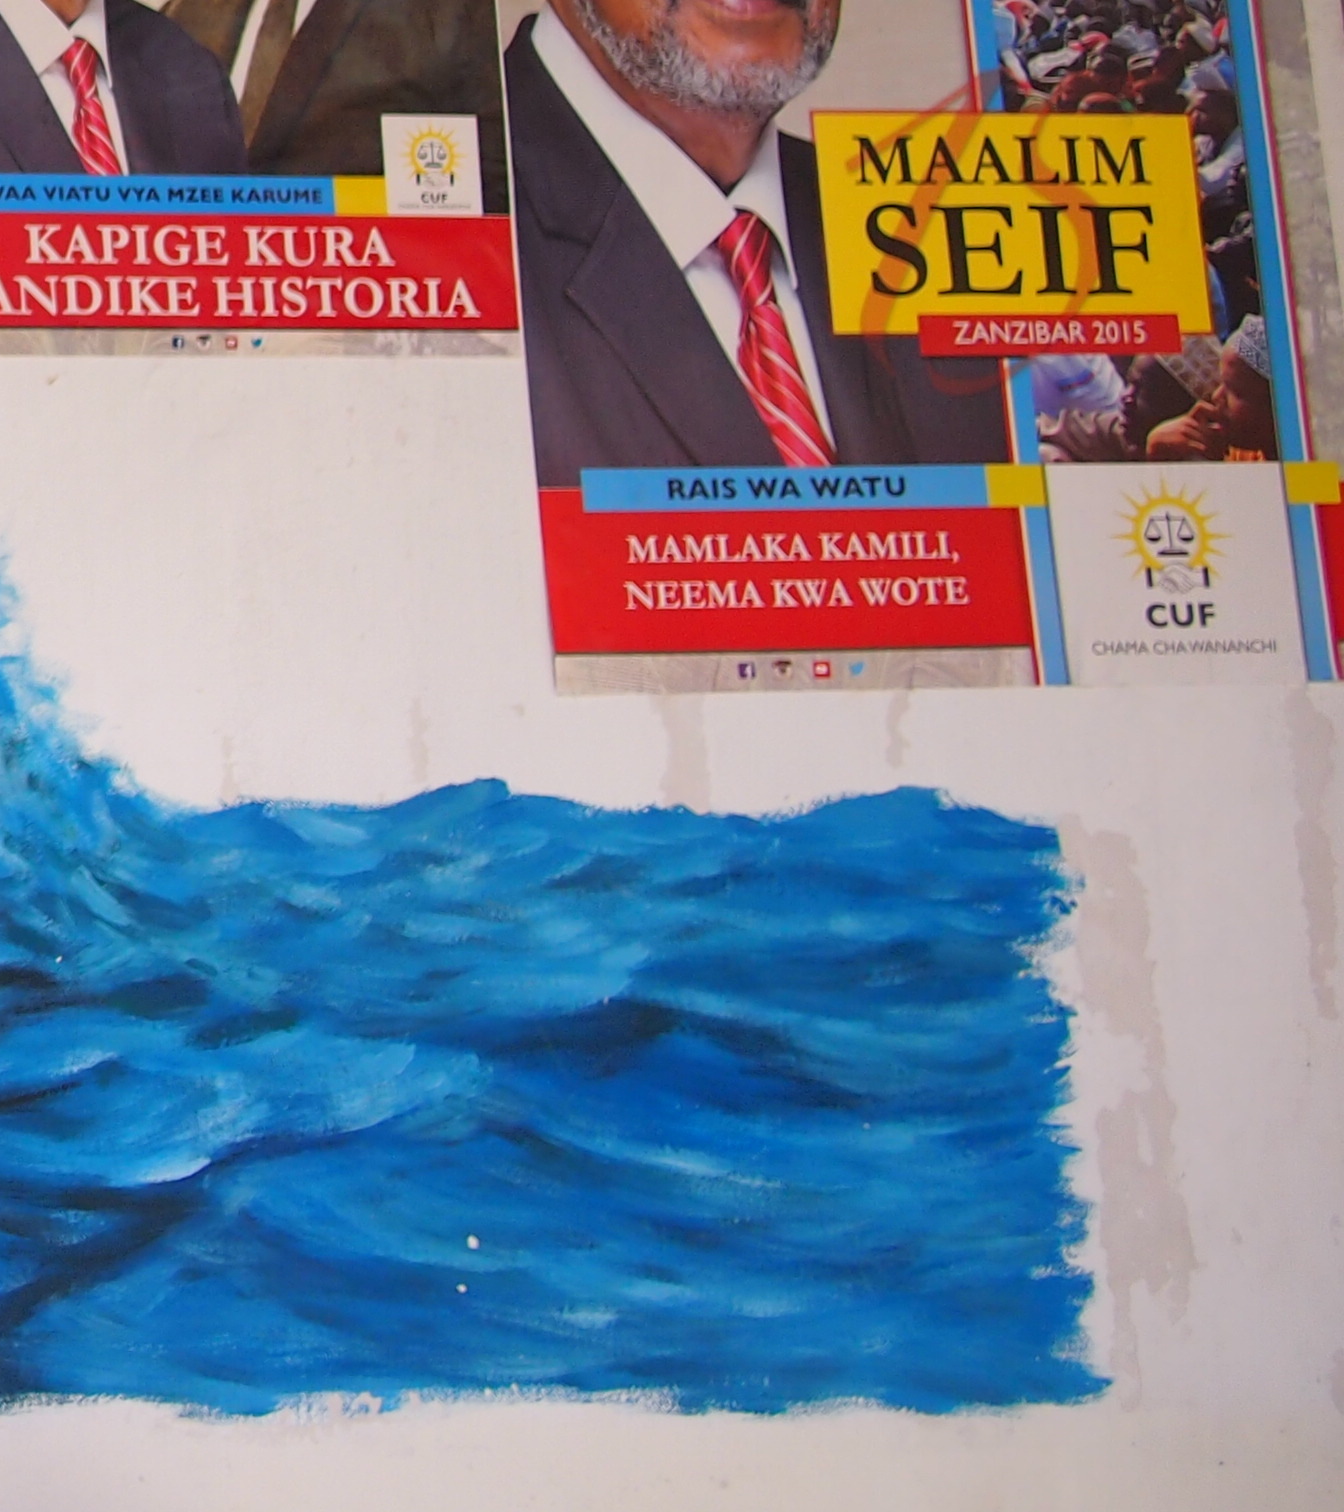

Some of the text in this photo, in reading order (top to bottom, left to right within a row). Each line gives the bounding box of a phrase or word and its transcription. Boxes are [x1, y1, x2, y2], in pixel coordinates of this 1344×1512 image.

[853, 136, 1152, 186] MAALIM
[45, 185, 110, 202] VIATU
[118, 186, 160, 203] VYA
[168, 187, 224, 204] MZEE
[231, 188, 323, 205] KARUME
[421, 192, 447, 204] CUF
[24, 224, 395, 267] KAPIGE KURA
[865, 204, 1154, 296] SEIF
[212, 276, 480, 319] HISTORIA
[954, 321, 1146, 345] ZANZIBAR 2015
[667, 476, 906, 500] RAIS WA WATU
[625, 531, 960, 563] MAMLAKA KAMILI,
[623, 576, 969, 610] NEEMA KWA WOTE
[1146, 603, 1215, 628] CUF
[1092, 639, 1277, 656] CHAMA CHA WANANCHI
